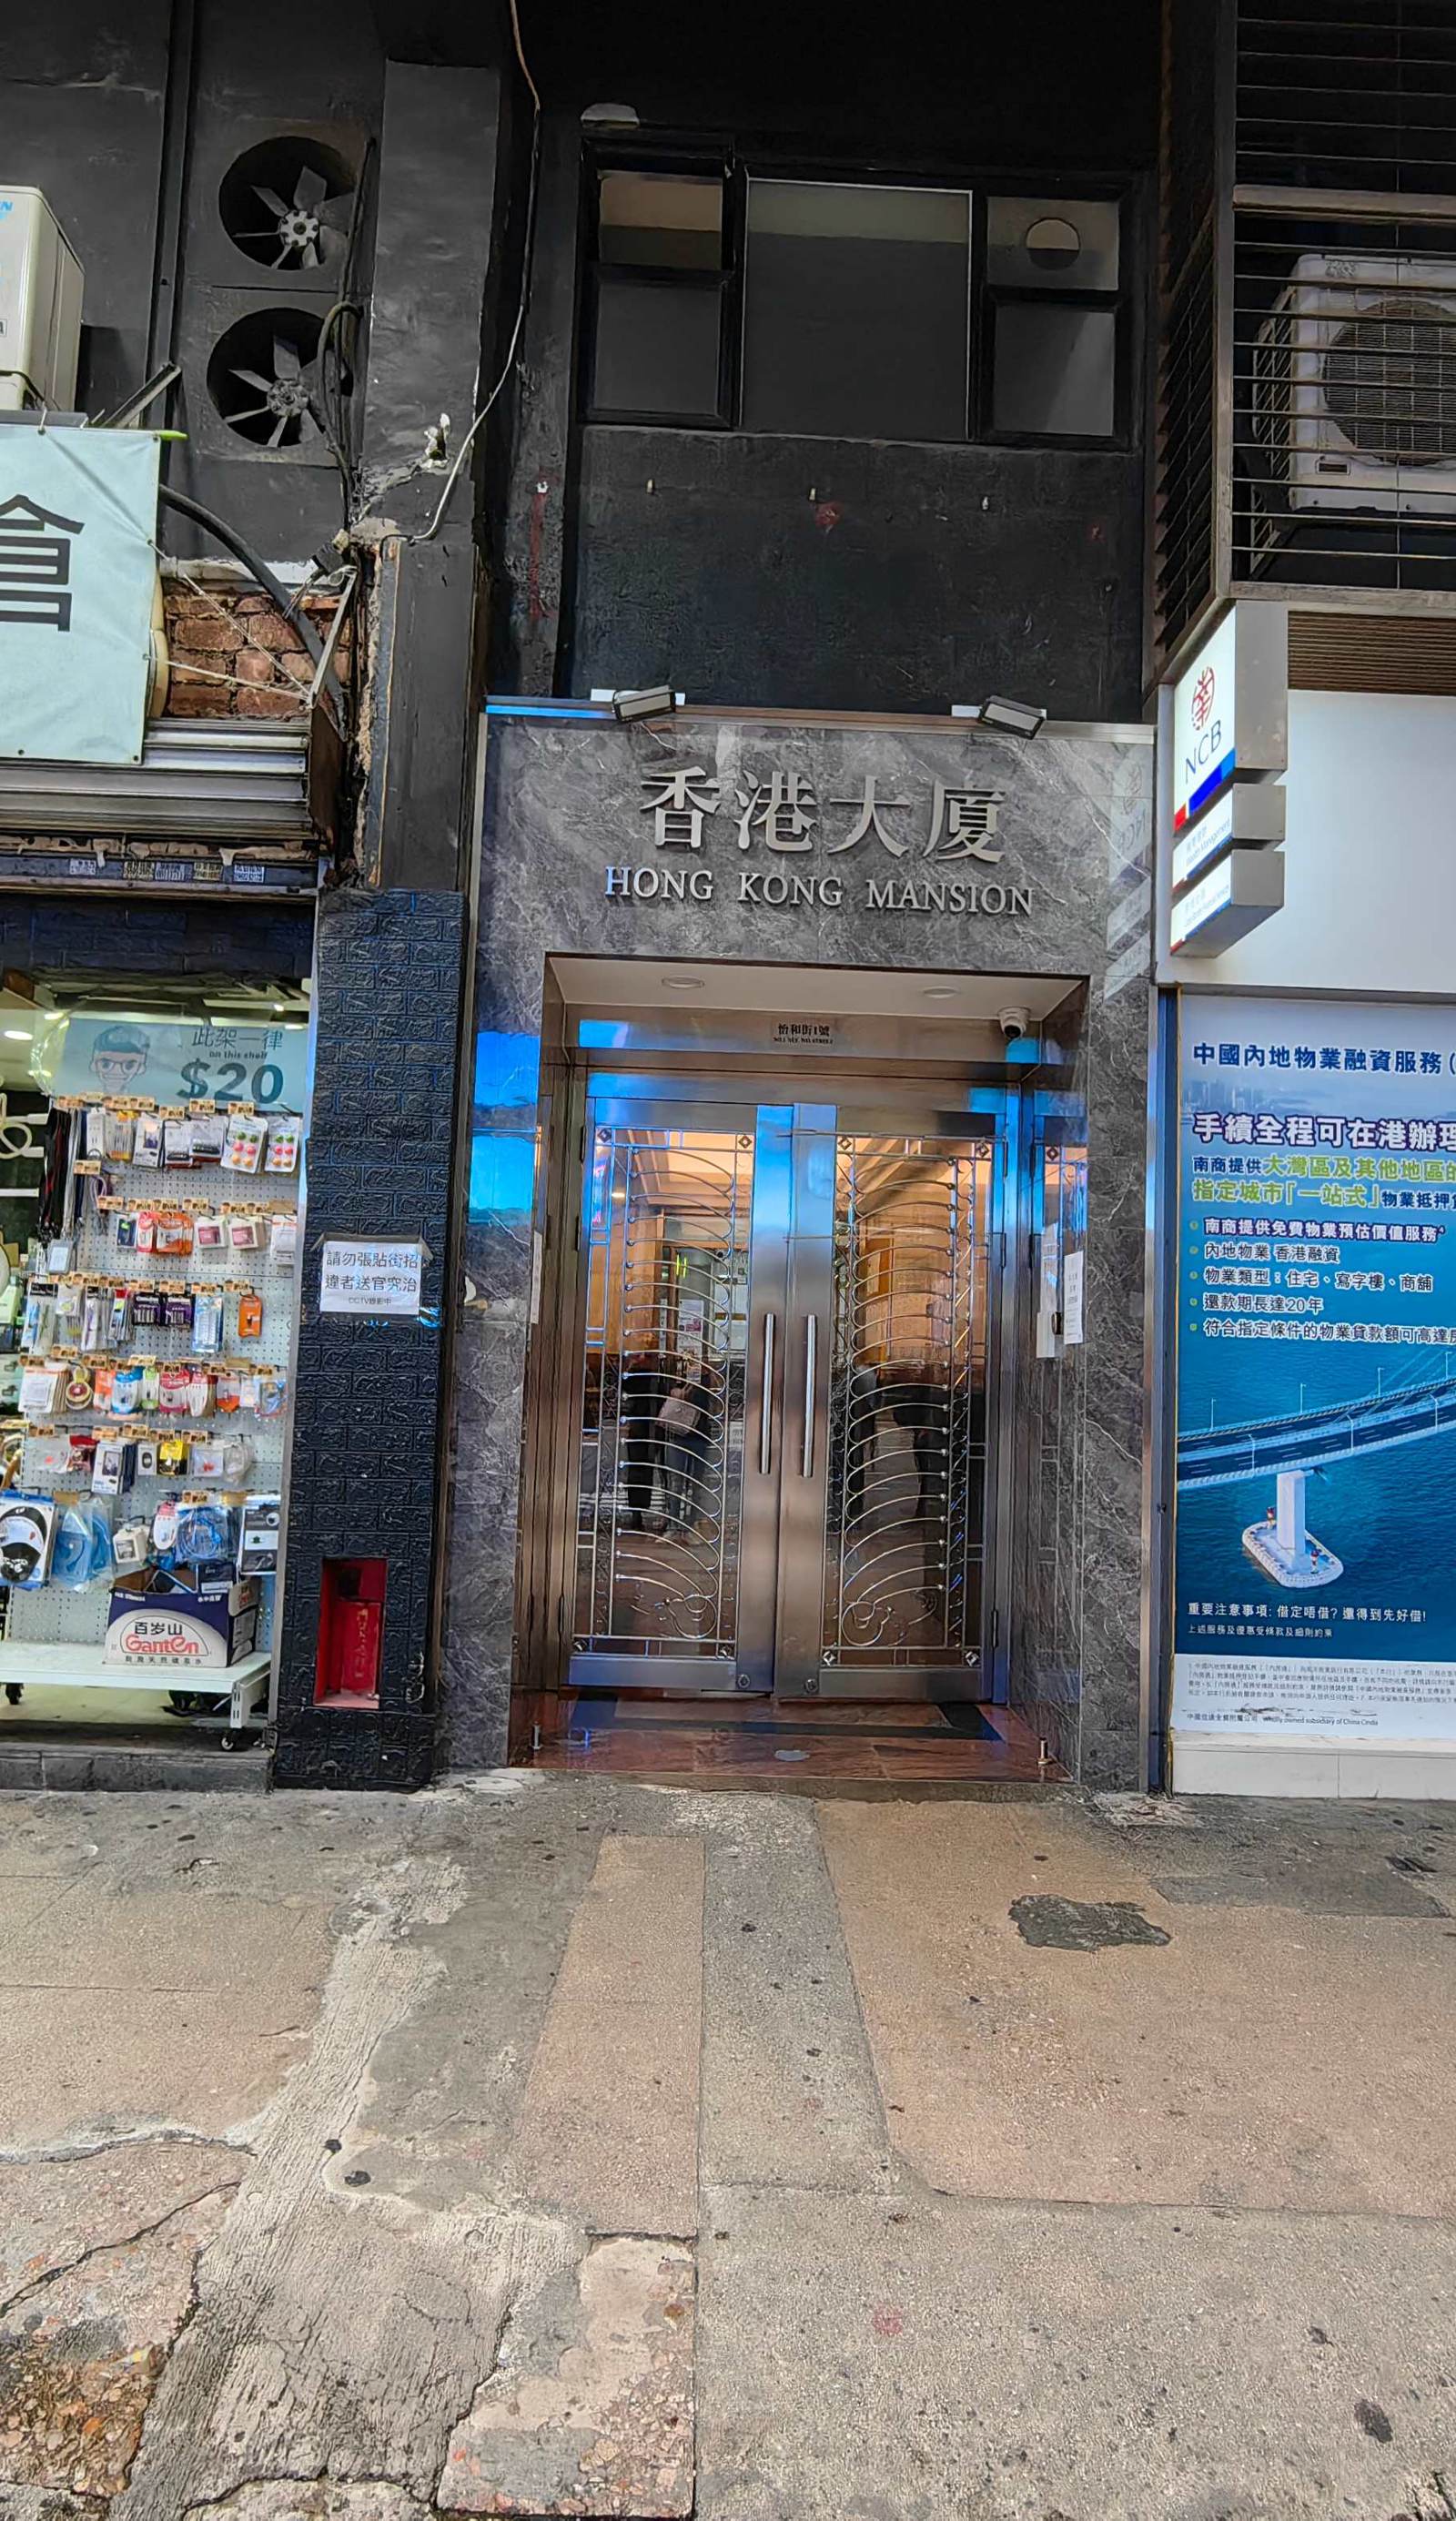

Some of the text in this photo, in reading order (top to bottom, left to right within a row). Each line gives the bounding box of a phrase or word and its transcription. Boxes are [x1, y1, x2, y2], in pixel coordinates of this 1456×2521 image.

[1186, 719, 1221, 785] NCB
[641, 766, 1006, 863] 香港大廈
[605, 866, 1035, 916] HONG KONG MANSION
[192, 1027, 283, 1050] 此架一律
[225, 1050, 241, 1059] this
[244, 1050, 268, 1060] shelf
[177, 1058, 284, 1104] $20
[327, 1250, 418, 1269] 請勿張貼街招
[1276, 1245, 1340, 1263] 香港融資
[325, 1274, 417, 1292] 違者送官究治
[1204, 1294, 1323, 1314] 還款期長達20年
[135, 1621, 182, 1635] 百岁山
